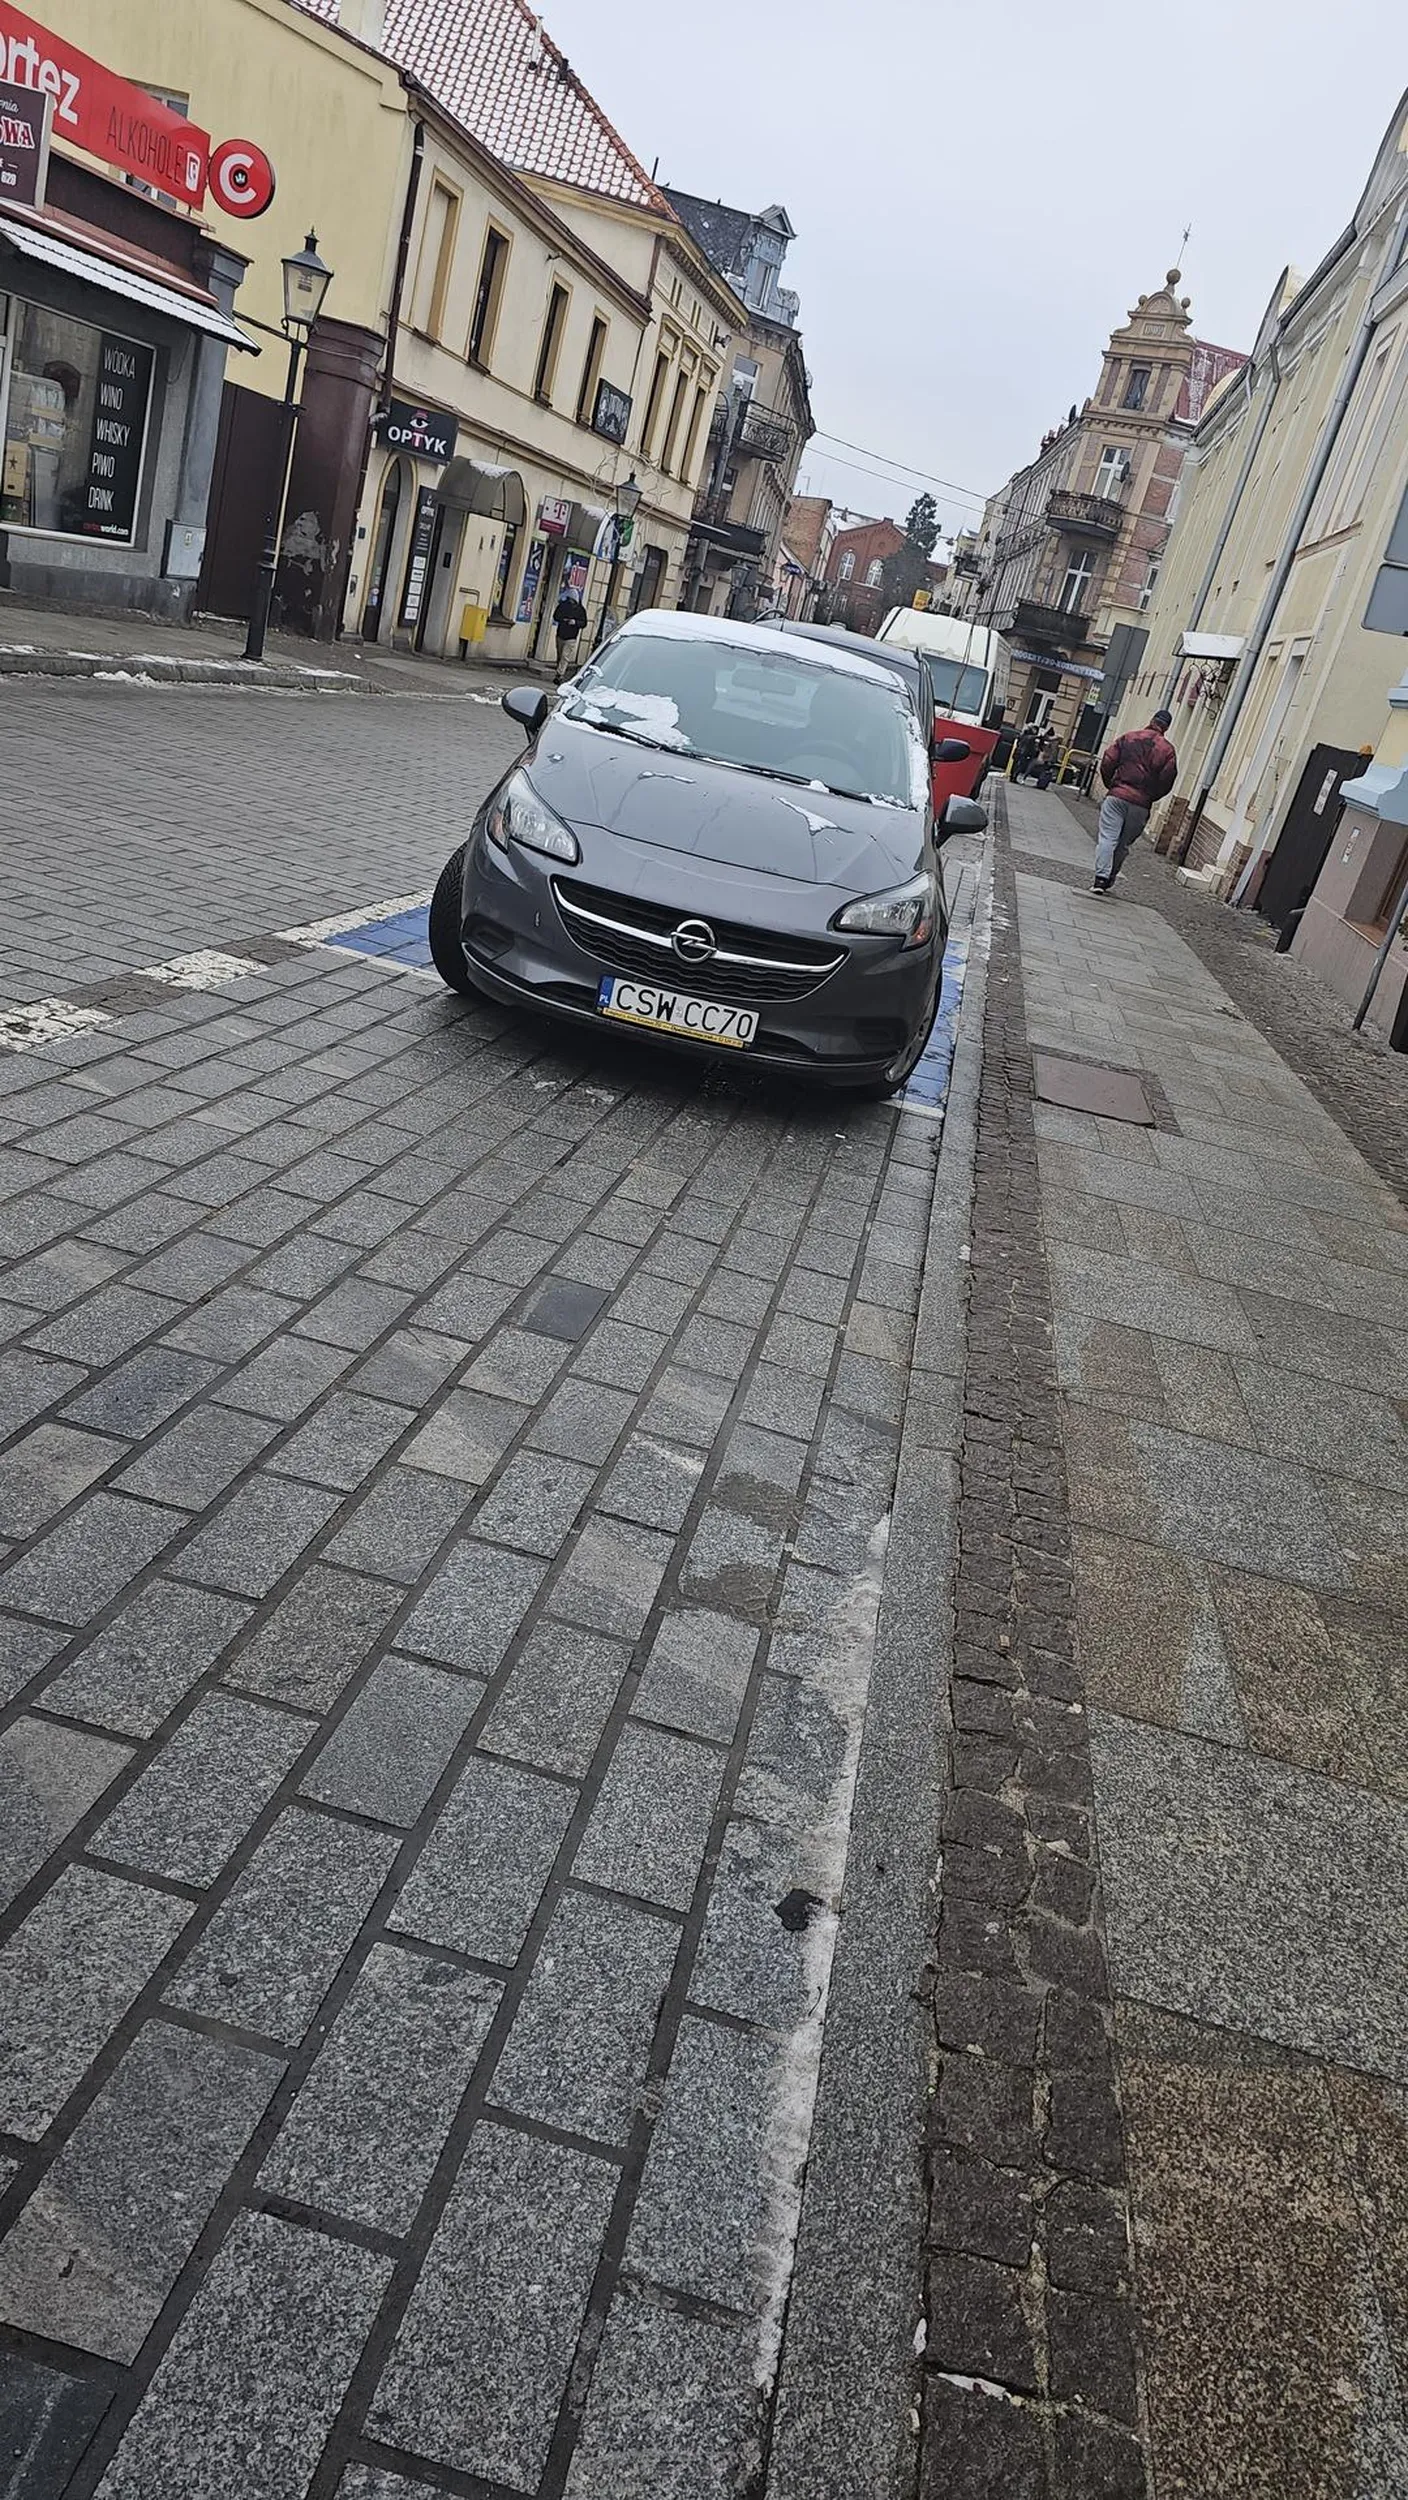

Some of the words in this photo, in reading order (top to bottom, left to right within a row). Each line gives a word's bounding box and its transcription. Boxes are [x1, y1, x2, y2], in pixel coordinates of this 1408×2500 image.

[0, 31, 80, 125] rtez
[0, 98, 19, 113] nia
[0, 117, 35, 149] WA
[106, 106, 182, 184] ALKOHOLE
[219, 153, 257, 204] C
[104, 347, 136, 380] WÓDKA
[100, 383, 123, 410] WINO
[97, 418, 131, 447] WHISKY
[387, 426, 447, 455] OPTYK
[92, 452, 115, 478] PIWO
[88, 486, 114, 512] DRINK
[599, 994, 609, 1004] PL
[616, 984, 676, 1022] CSW
[684, 1001, 753, 1039] CC70
